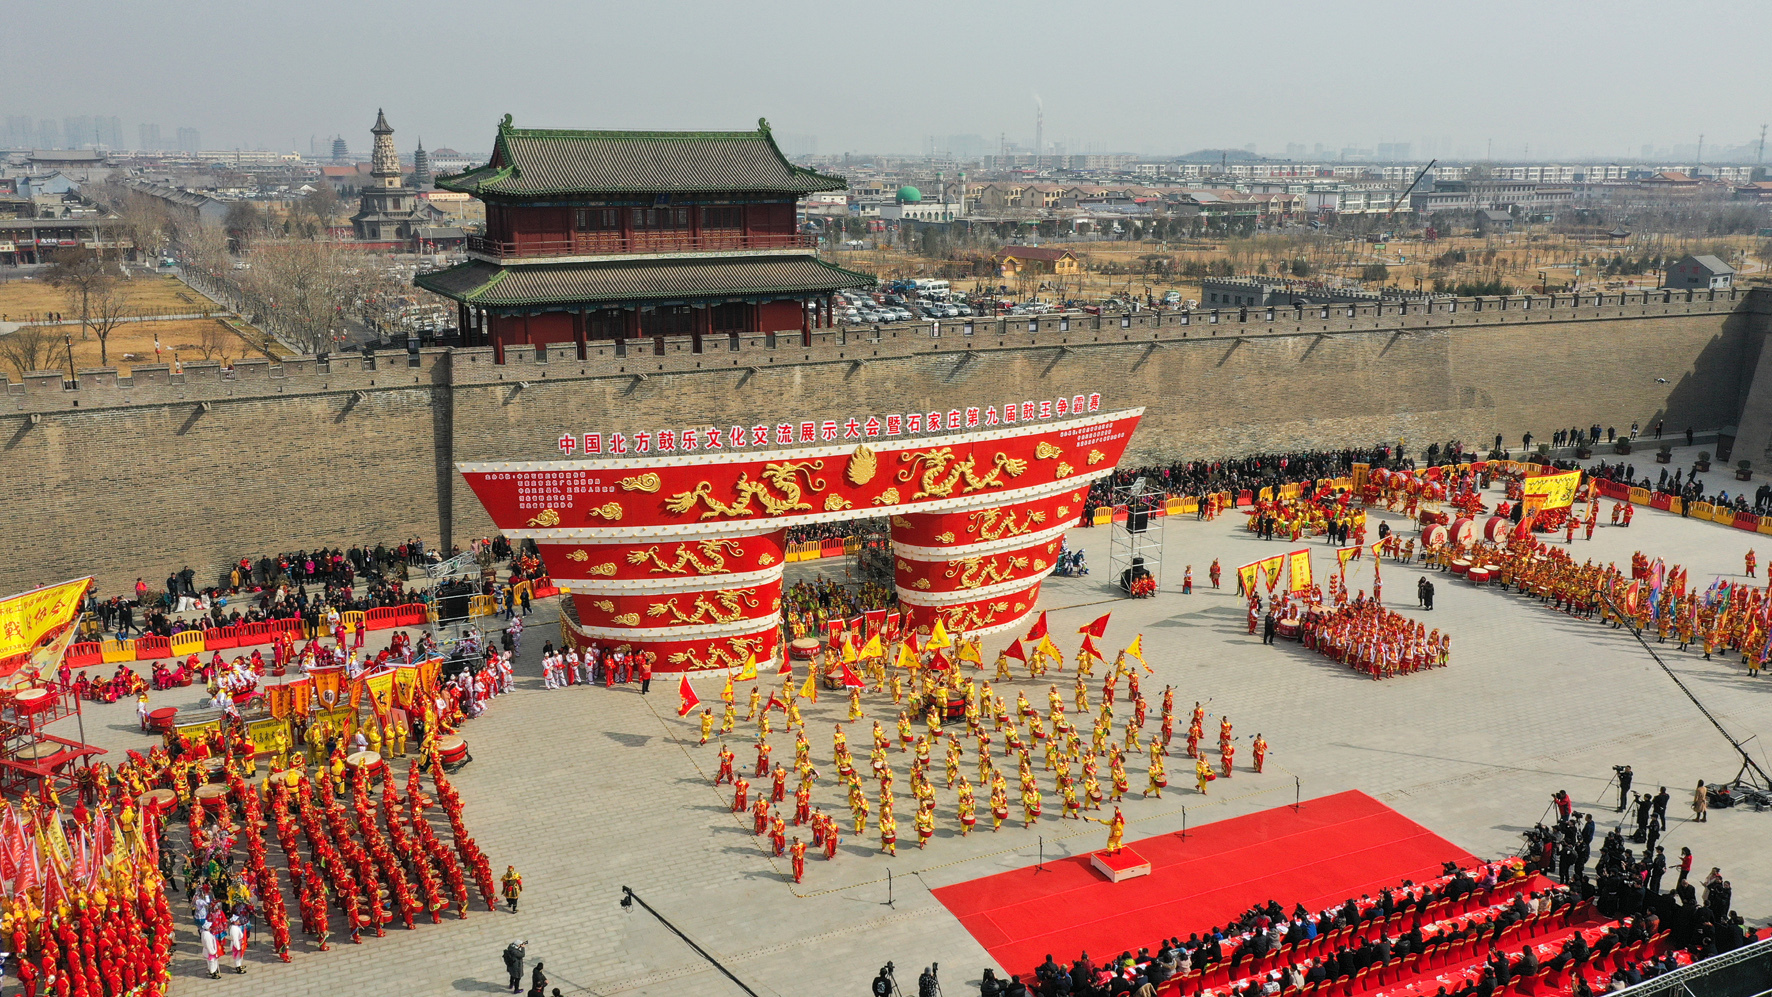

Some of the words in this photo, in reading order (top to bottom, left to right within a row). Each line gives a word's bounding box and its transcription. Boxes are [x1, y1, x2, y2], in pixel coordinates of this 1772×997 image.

[558, 392, 1101, 456] 中国北方鼓乐文化交流展示大会暨石家庄第九届鼓王争霸赛
[1495, 525, 1507, 537] 威
